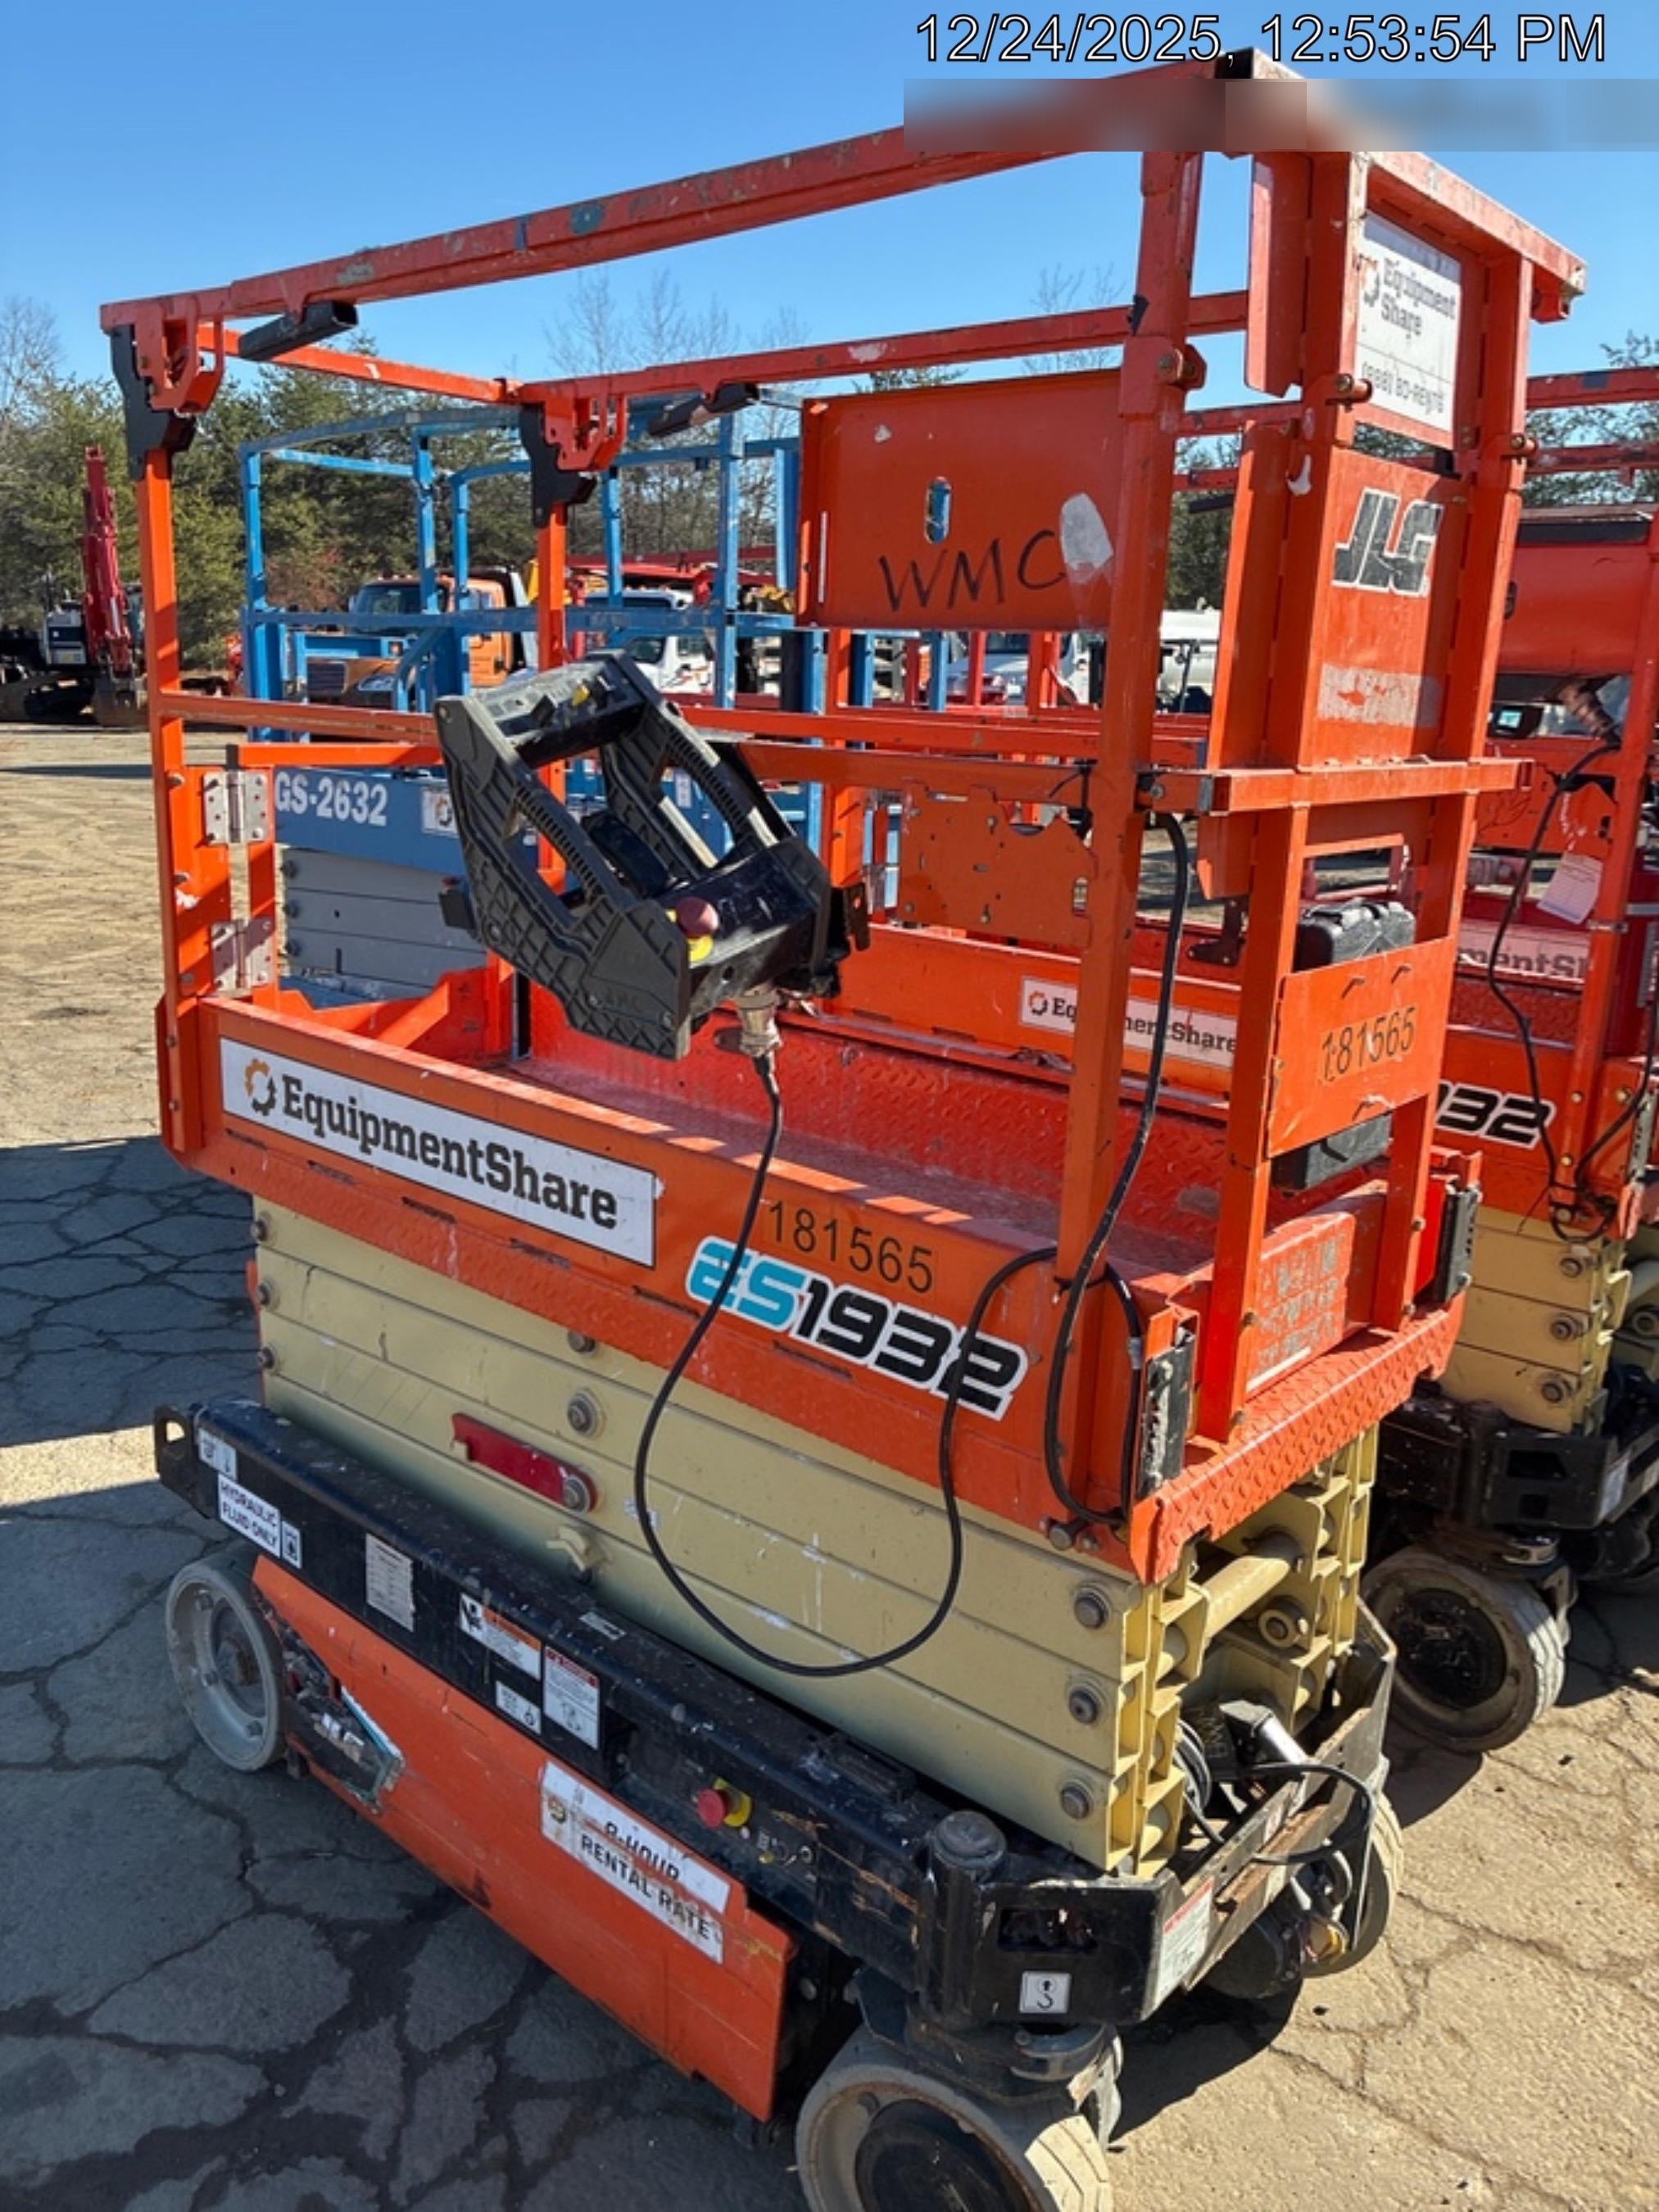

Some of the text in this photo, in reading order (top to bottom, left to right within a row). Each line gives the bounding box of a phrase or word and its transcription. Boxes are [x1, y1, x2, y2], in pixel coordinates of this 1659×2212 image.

[274, 771, 388, 827] GS-2632
[1321, 1007, 1416, 1082] 181565
[281, 1074, 617, 1230] EquipmentShare
[768, 1201, 933, 1293] 181565
[686, 1235, 1027, 1421] ES1932
[581, 1834, 710, 1941] RENTAL RATE
